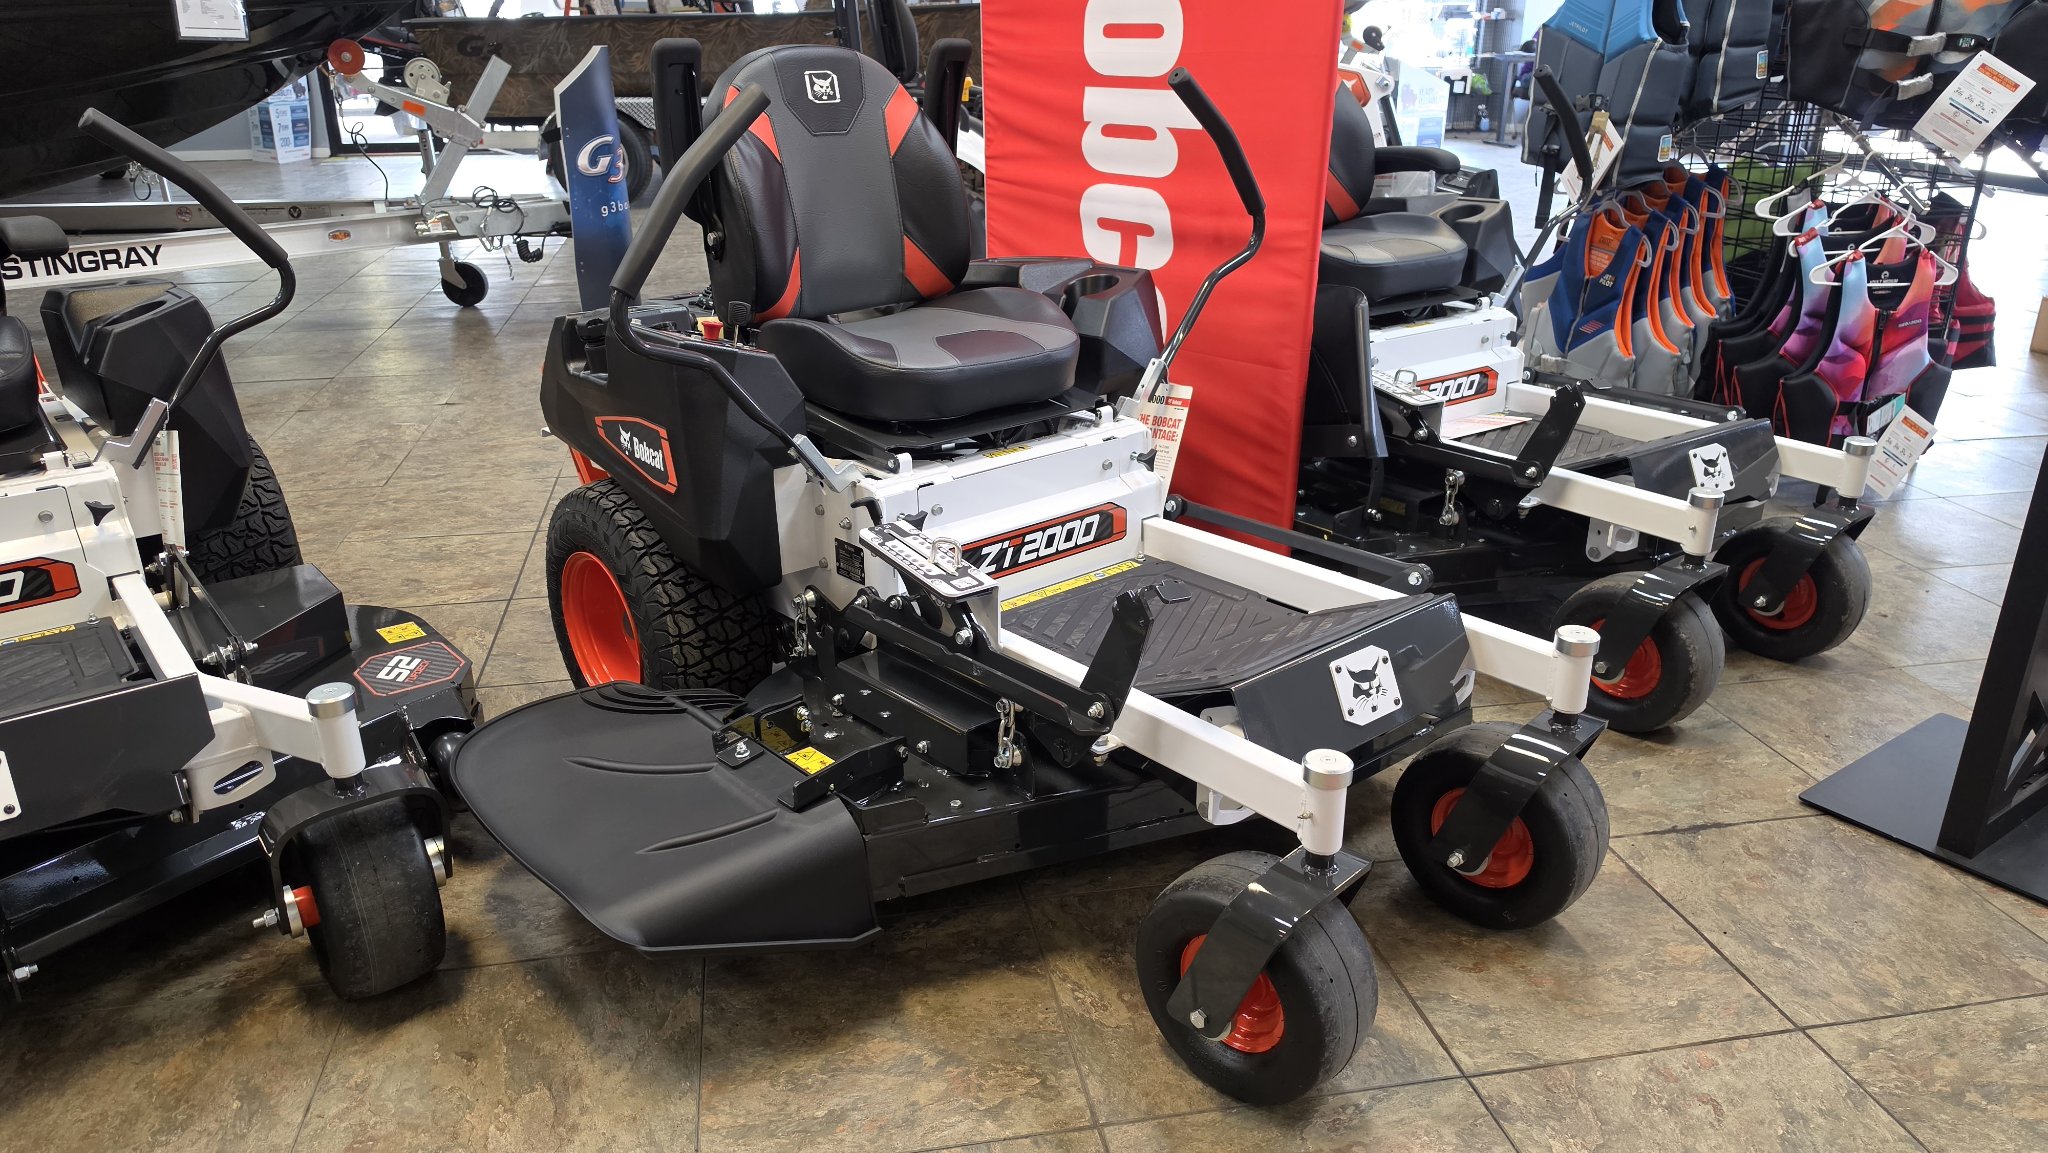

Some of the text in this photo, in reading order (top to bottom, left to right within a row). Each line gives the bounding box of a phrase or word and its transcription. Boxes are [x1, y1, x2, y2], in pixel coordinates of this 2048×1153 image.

[576, 133, 624, 184] G3
[1, 244, 162, 280] STINGRAY
[1151, 415, 1183, 430] BOBCAT
[632, 436, 664, 472] Bobcat
[979, 513, 1101, 575] ZT2000
[375, 654, 422, 682] 52
